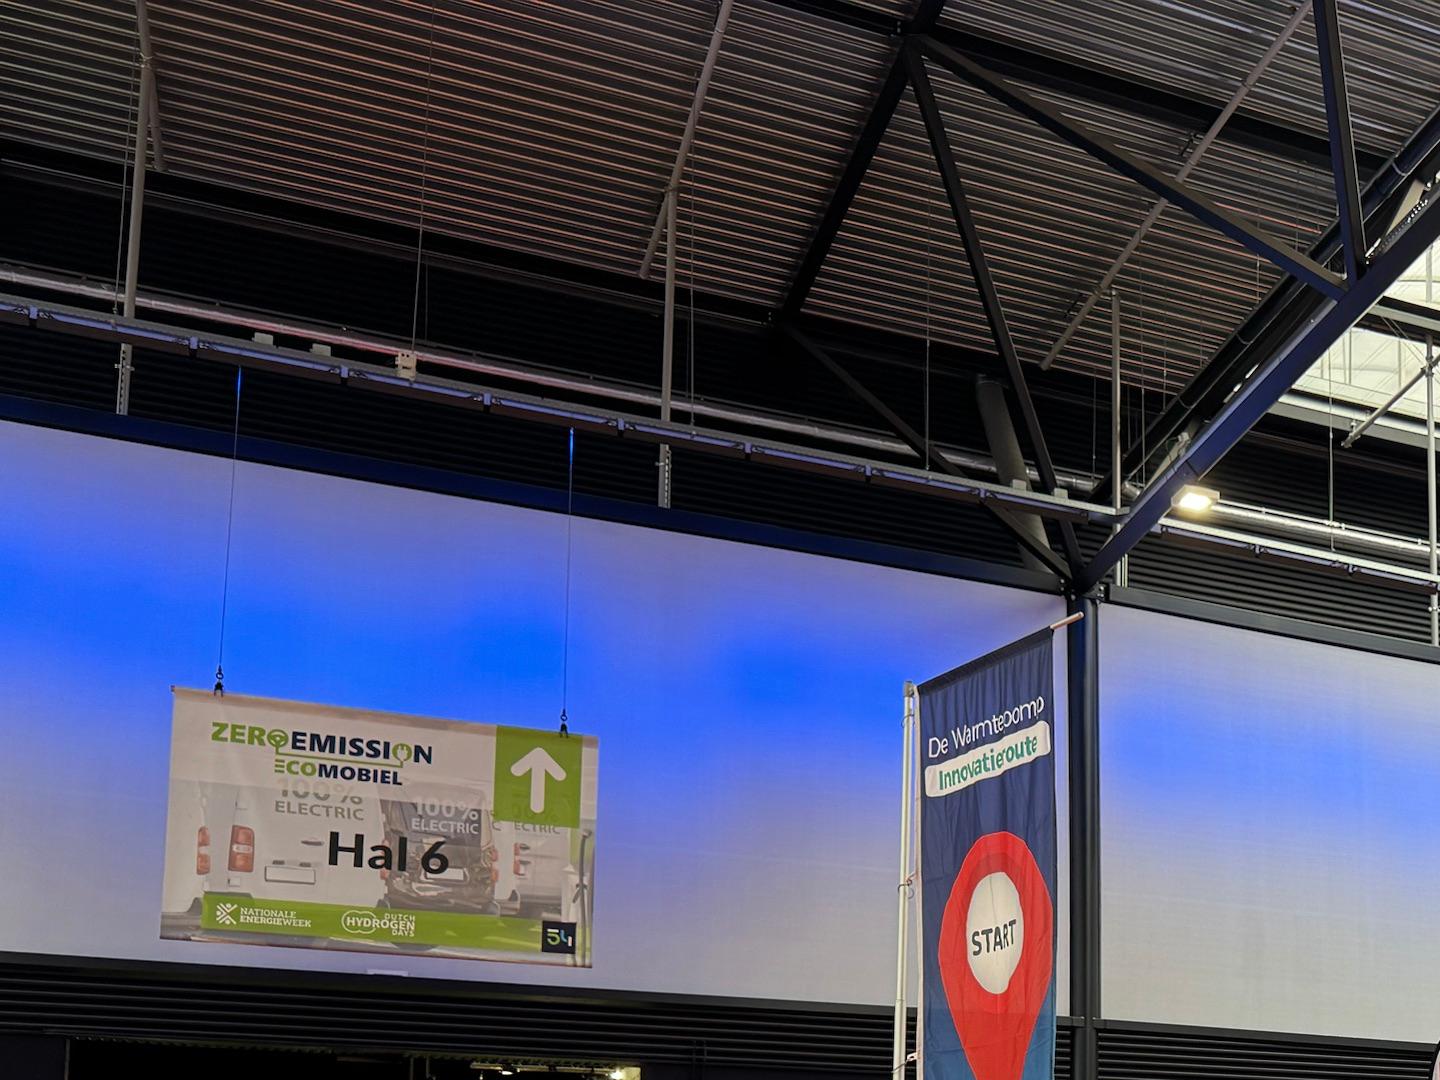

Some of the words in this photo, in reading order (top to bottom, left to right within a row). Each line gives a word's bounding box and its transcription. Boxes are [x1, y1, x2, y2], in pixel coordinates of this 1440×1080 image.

[928, 736, 949, 759] De
[274, 758, 404, 786] ECOMOBIEL
[938, 735, 1038, 791] Innovatieroute
[274, 800, 365, 821] ELECTRIC
[411, 818, 480, 835] ELECTRIC
[327, 831, 408, 873] Hal
[421, 840, 450, 875] 6
[239, 915, 312, 928] ENERGIEWEEK
[240, 907, 297, 919] NATIONALE
[384, 912, 416, 921] DUTCH
[346, 916, 416, 930] HYDROGEN
[391, 929, 415, 937] DAYS
[971, 919, 1017, 957] START
